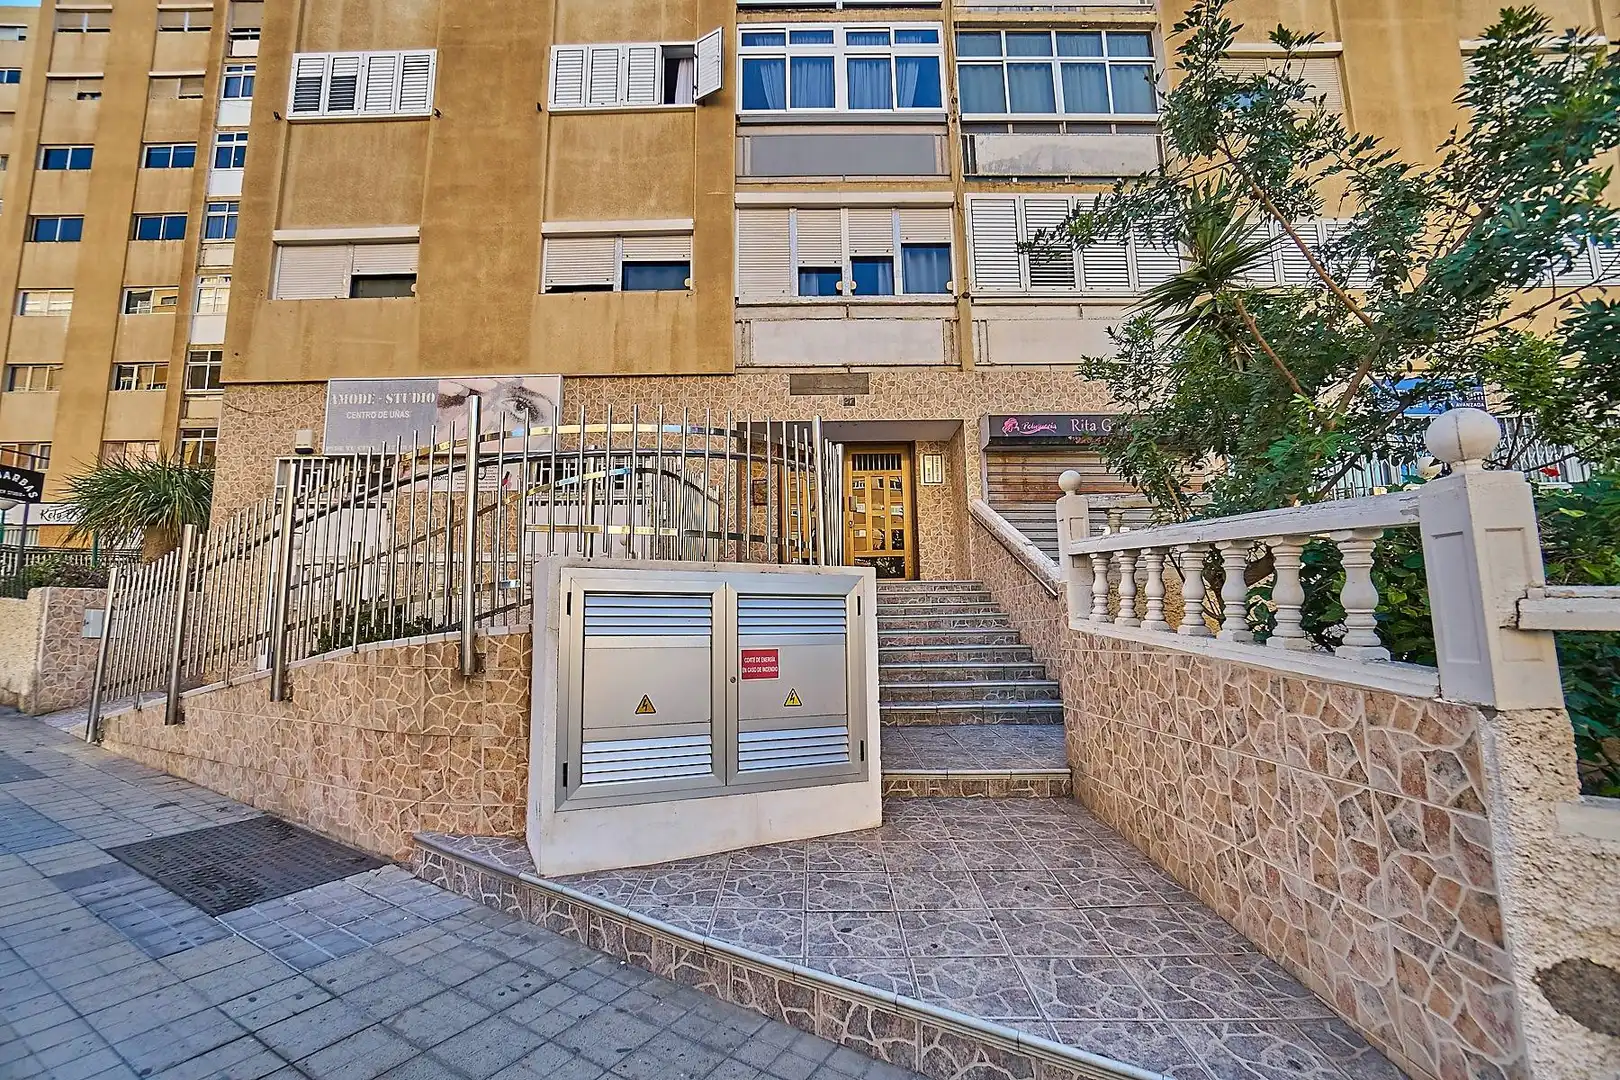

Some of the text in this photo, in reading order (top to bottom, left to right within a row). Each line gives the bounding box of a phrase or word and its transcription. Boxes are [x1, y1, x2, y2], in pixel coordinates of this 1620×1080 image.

[385, 391, 436, 404] STUDIO
[346, 409, 411, 419] CENTRO DE UÑAS
[1071, 418, 1097, 432] Rita
[0, 471, 38, 498] ARBAS
